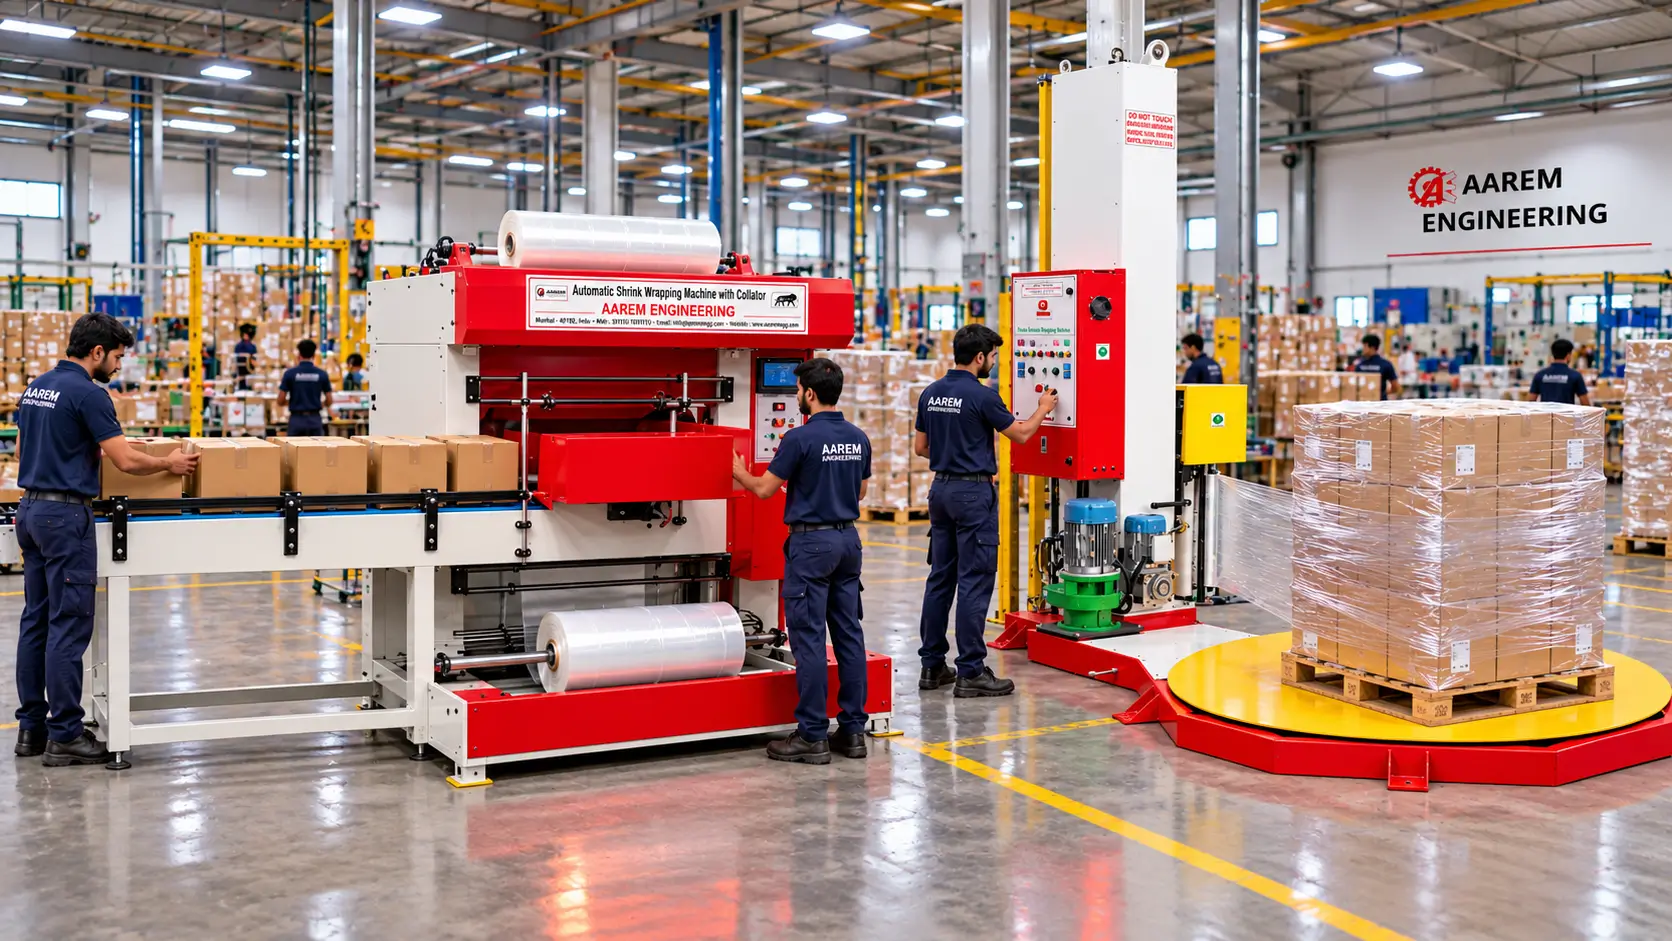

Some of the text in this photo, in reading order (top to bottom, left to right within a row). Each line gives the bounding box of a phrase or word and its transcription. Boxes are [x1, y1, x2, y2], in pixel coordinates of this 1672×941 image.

[1462, 167, 1562, 195] AAREM
[1423, 203, 1608, 233] ENGINEERING
[572, 284, 614, 297] Automatic
[616, 286, 642, 298] Shrink
[644, 287, 682, 301] Wrapping
[684, 287, 717, 300] Machine
[718, 288, 735, 300] with
[736, 289, 767, 301] Collator
[601, 302, 736, 317] AAREM ENGINEERING
[23, 387, 60, 402] AAREM
[927, 396, 963, 408] AAREM
[821, 443, 862, 455] AAREM
